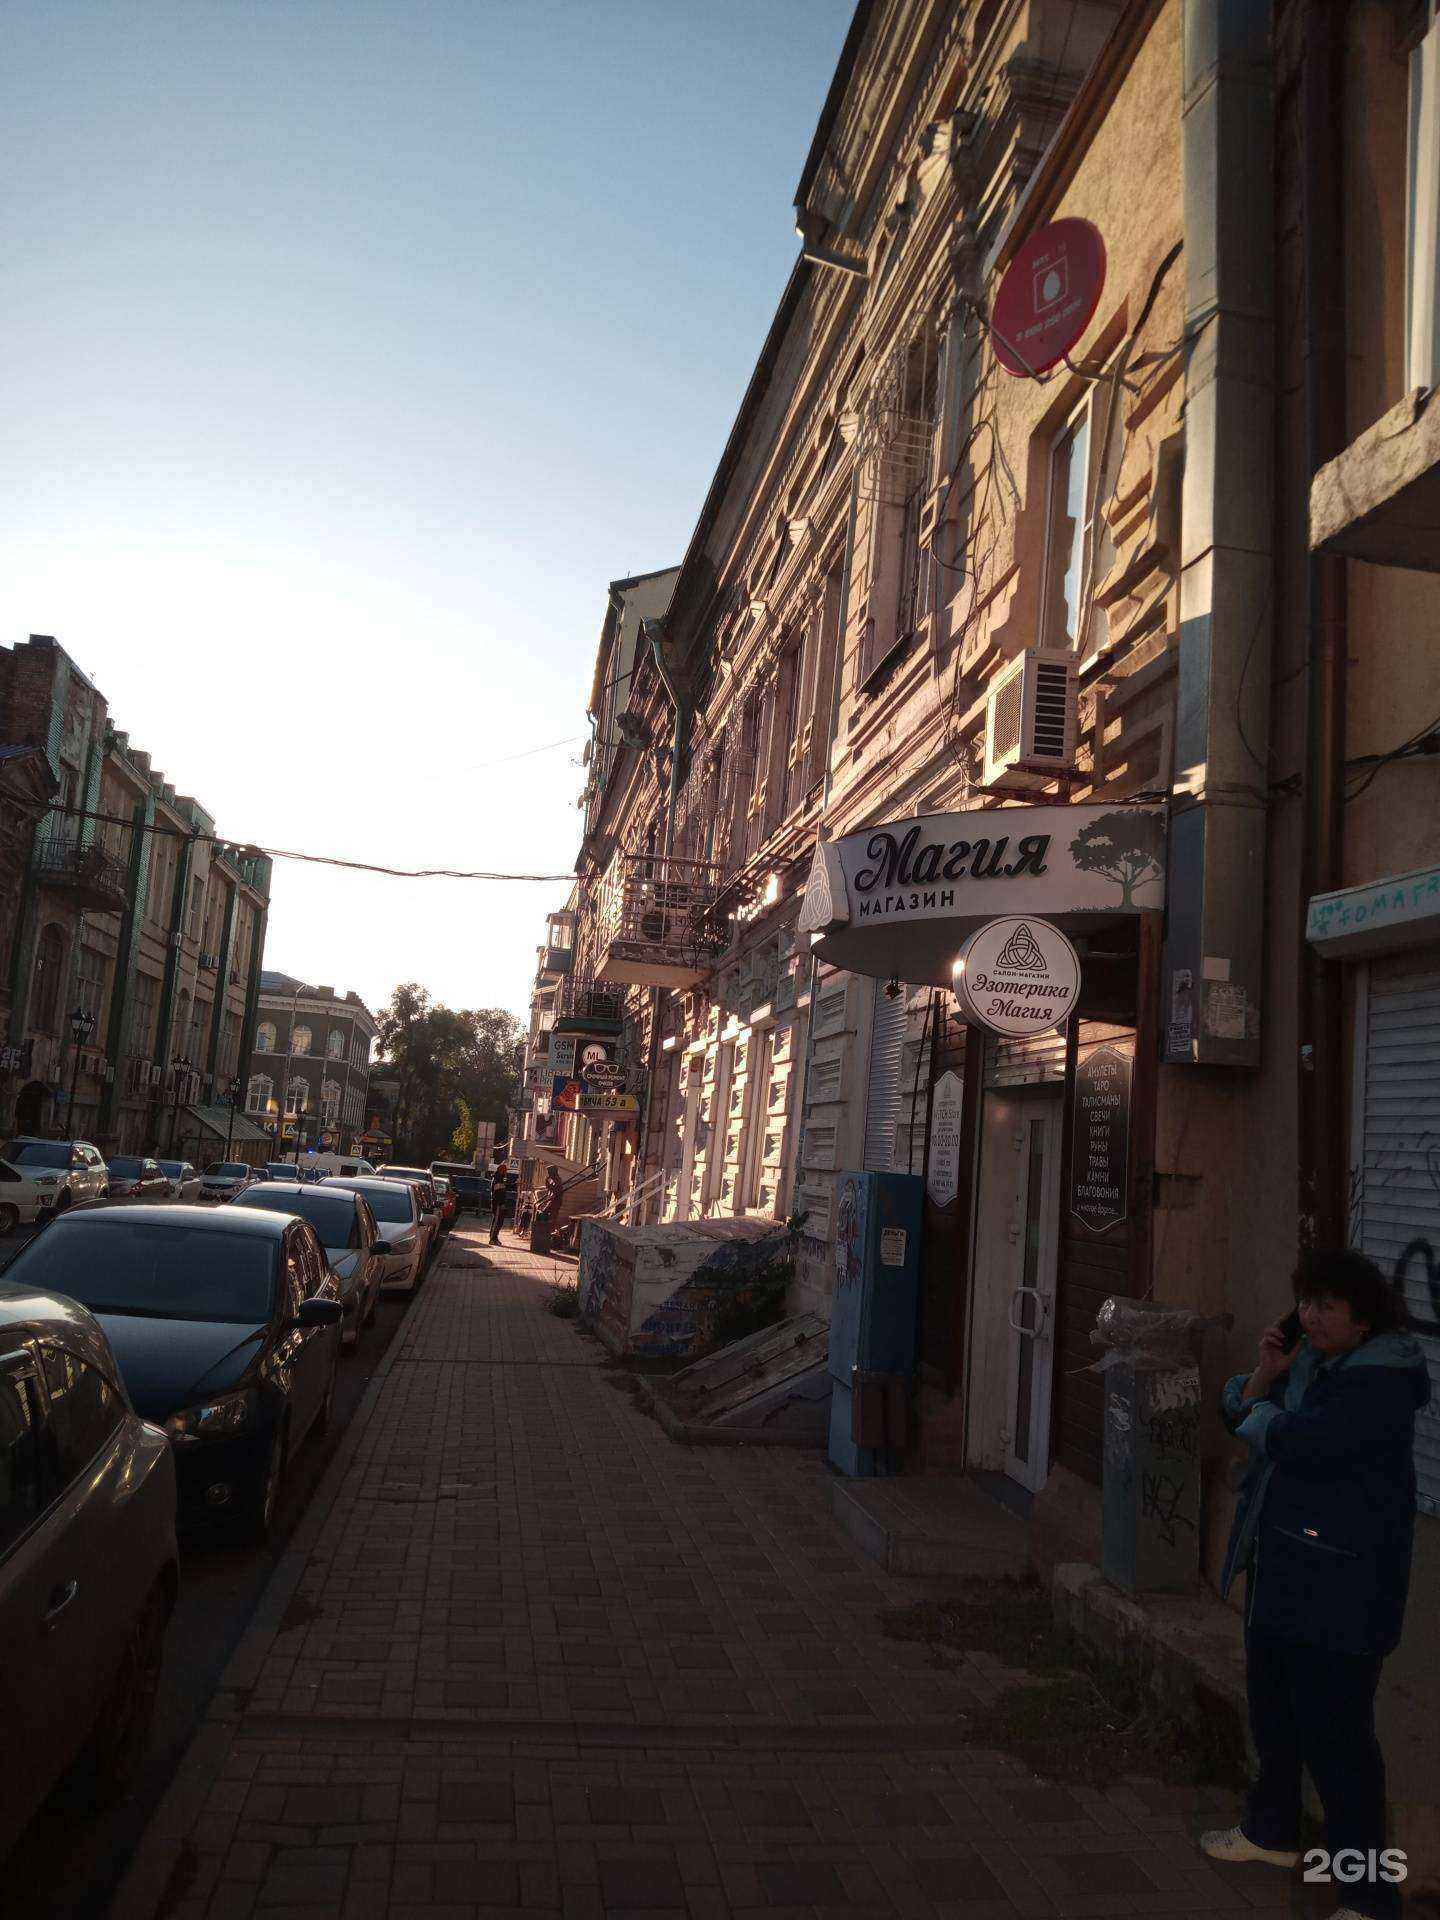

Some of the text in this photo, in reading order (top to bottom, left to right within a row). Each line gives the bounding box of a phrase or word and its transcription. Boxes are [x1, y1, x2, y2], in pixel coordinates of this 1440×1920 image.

[855, 825, 1052, 891] Магия
[858, 890, 954, 917] МАГАЗИН
[971, 973, 1070, 999] Эзотерика
[986, 998, 1053, 1021] Магия
[1088, 1064, 1117, 1079] АМУЛЕТЫ
[1093, 1080, 1110, 1092] ТАРО
[1082, 1094, 1120, 1108] ТАЛИСМАНЫ
[1089, 1110, 1111, 1123] СВЕЧИ
[1089, 1125, 1111, 1138] КНИГИ
[1089, 1140, 1109, 1153] РУНЫ
[1089, 1155, 1109, 1169] ТРАВЫ
[1087, 1170, 1110, 1184] КАМНИ
[1077, 1184, 1120, 1199] БЛАГОВОНИЯ
